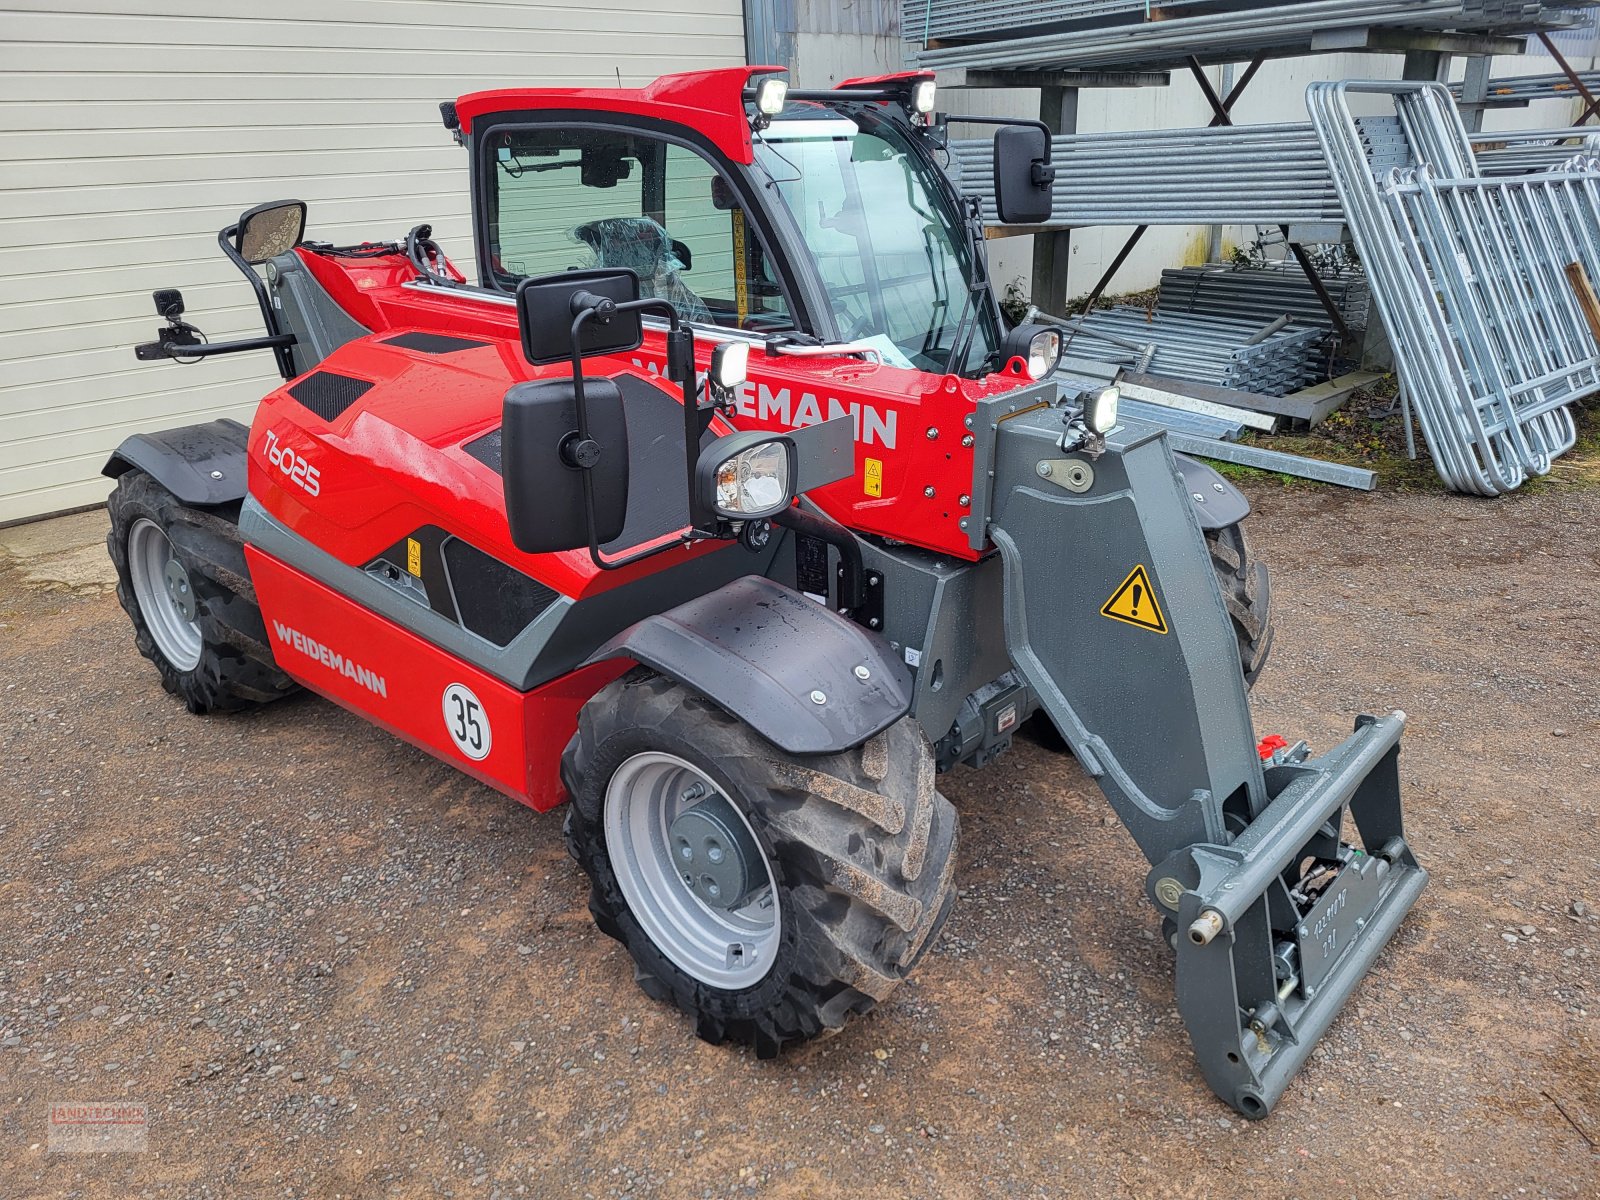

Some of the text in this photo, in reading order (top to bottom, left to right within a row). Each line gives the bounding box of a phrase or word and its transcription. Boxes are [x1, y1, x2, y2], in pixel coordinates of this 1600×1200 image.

[631, 358, 897, 449] EMANN
[263, 429, 320, 497] T6025
[272, 619, 387, 698] WEIDEMANN
[451, 693, 482, 750] 35
